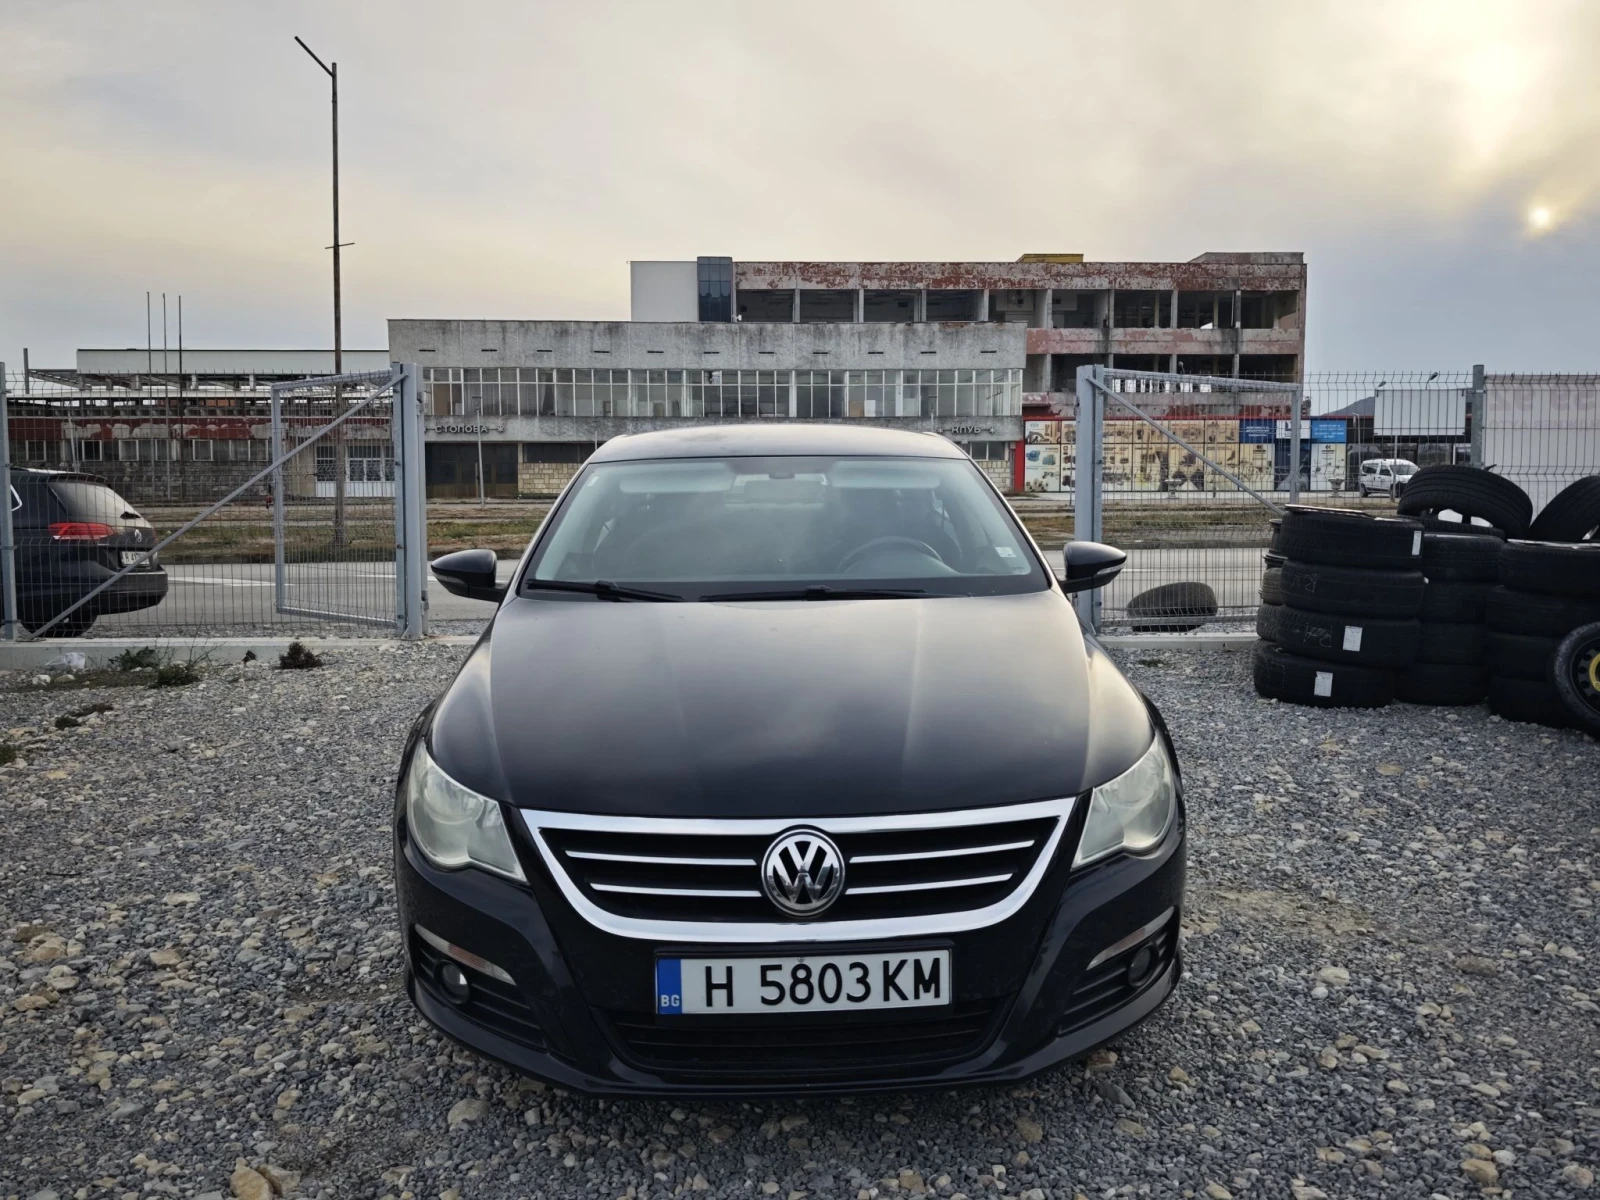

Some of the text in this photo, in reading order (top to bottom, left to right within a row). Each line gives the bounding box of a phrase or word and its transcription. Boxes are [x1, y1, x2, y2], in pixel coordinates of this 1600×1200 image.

[704, 956, 941, 1008] H 5803 KM
[660, 993, 681, 1007] BG
